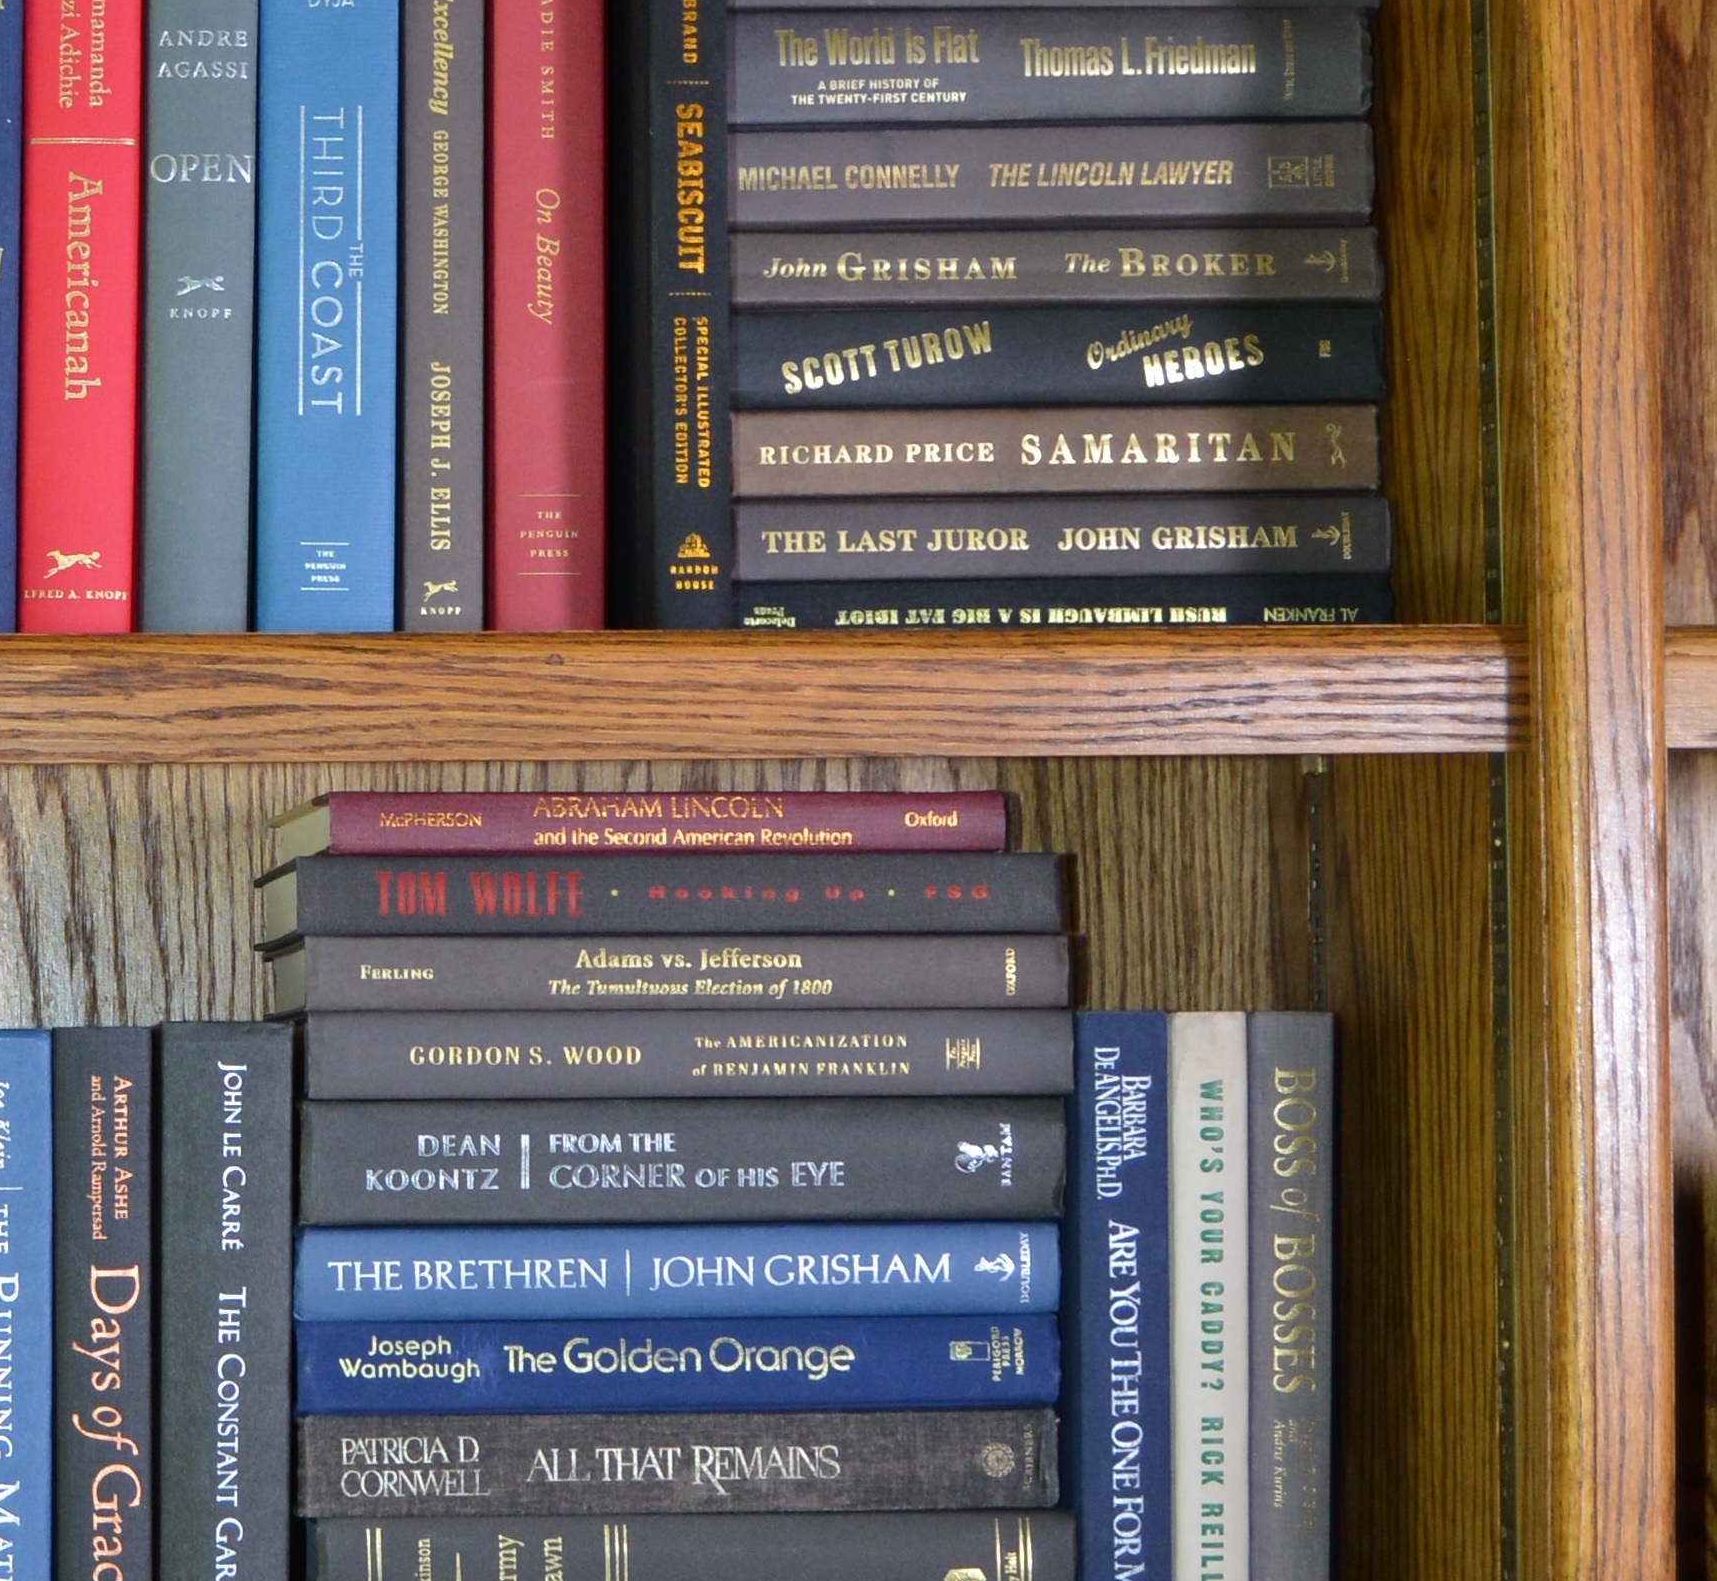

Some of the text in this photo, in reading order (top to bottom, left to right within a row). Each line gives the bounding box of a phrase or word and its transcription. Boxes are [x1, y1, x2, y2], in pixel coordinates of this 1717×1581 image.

[159, 30, 248, 47] ANDRE
[158, 61, 247, 79] AGASSI
[541, 66, 554, 138] SMITH
[151, 154, 252, 183] OPEN
[536, 188, 562, 224] On
[311, 107, 344, 414] THIRD COAST
[527, 233, 561, 324] Beauty
[65, 172, 103, 400] Americanah
[170, 308, 232, 318] KNOPF
[760, 431, 1296, 466] RICHARD PRICE SAMARITAN
[905, 811, 957, 827] Oxford
[418, 1134, 500, 1156] DEAN
[1200, 1080, 1224, 1173] WHO'S
[366, 1168, 499, 1191] KOONTZ
[1200, 1192, 1224, 1263] YOUR
[328, 1253, 950, 1291] THE BRETHREN JOHN GRISHAM
[73, 1265, 140, 1391] Days
[1200, 1282, 1224, 1390] CADDY?
[368, 1336, 451, 1360] Joseph
[503, 1337, 855, 1380] The Golden Orange
[339, 1358, 480, 1383] Wambaugh
[73, 1404, 139, 1457] of
[1201, 1418, 1224, 1485] RICK
